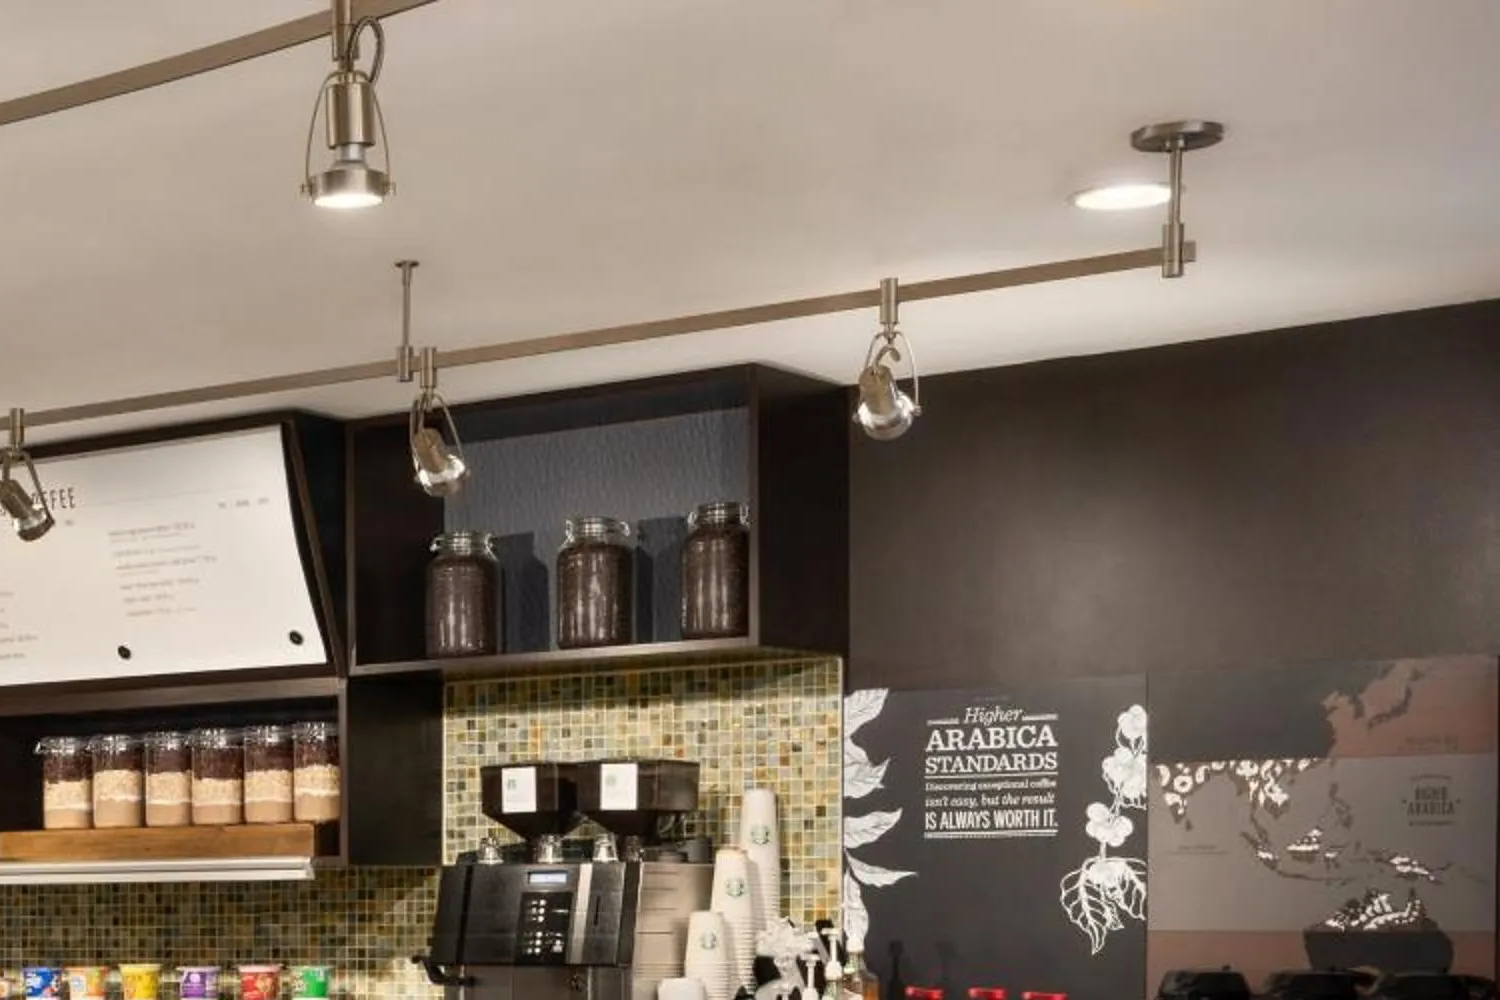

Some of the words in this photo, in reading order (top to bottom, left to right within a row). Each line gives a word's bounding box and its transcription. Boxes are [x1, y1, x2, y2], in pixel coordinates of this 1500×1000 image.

[962, 706, 1024, 727] Higher
[924, 724, 1059, 752] ARABICA
[924, 752, 1058, 775] STANDARDS
[925, 781, 977, 792] Discovering
[977, 779, 1029, 791] exceptional
[1030, 777, 1057, 788] coffee
[925, 795, 949, 807] isn't
[950, 796, 979, 808] easy,
[981, 793, 1000, 806] but
[1001, 793, 1020, 805] the
[1021, 792, 1056, 804] result
[924, 811, 937, 830] IS
[939, 810, 991, 830] ALWAYS
[993, 808, 1040, 829] WORTH
[1043, 808, 1059, 827] IT.
